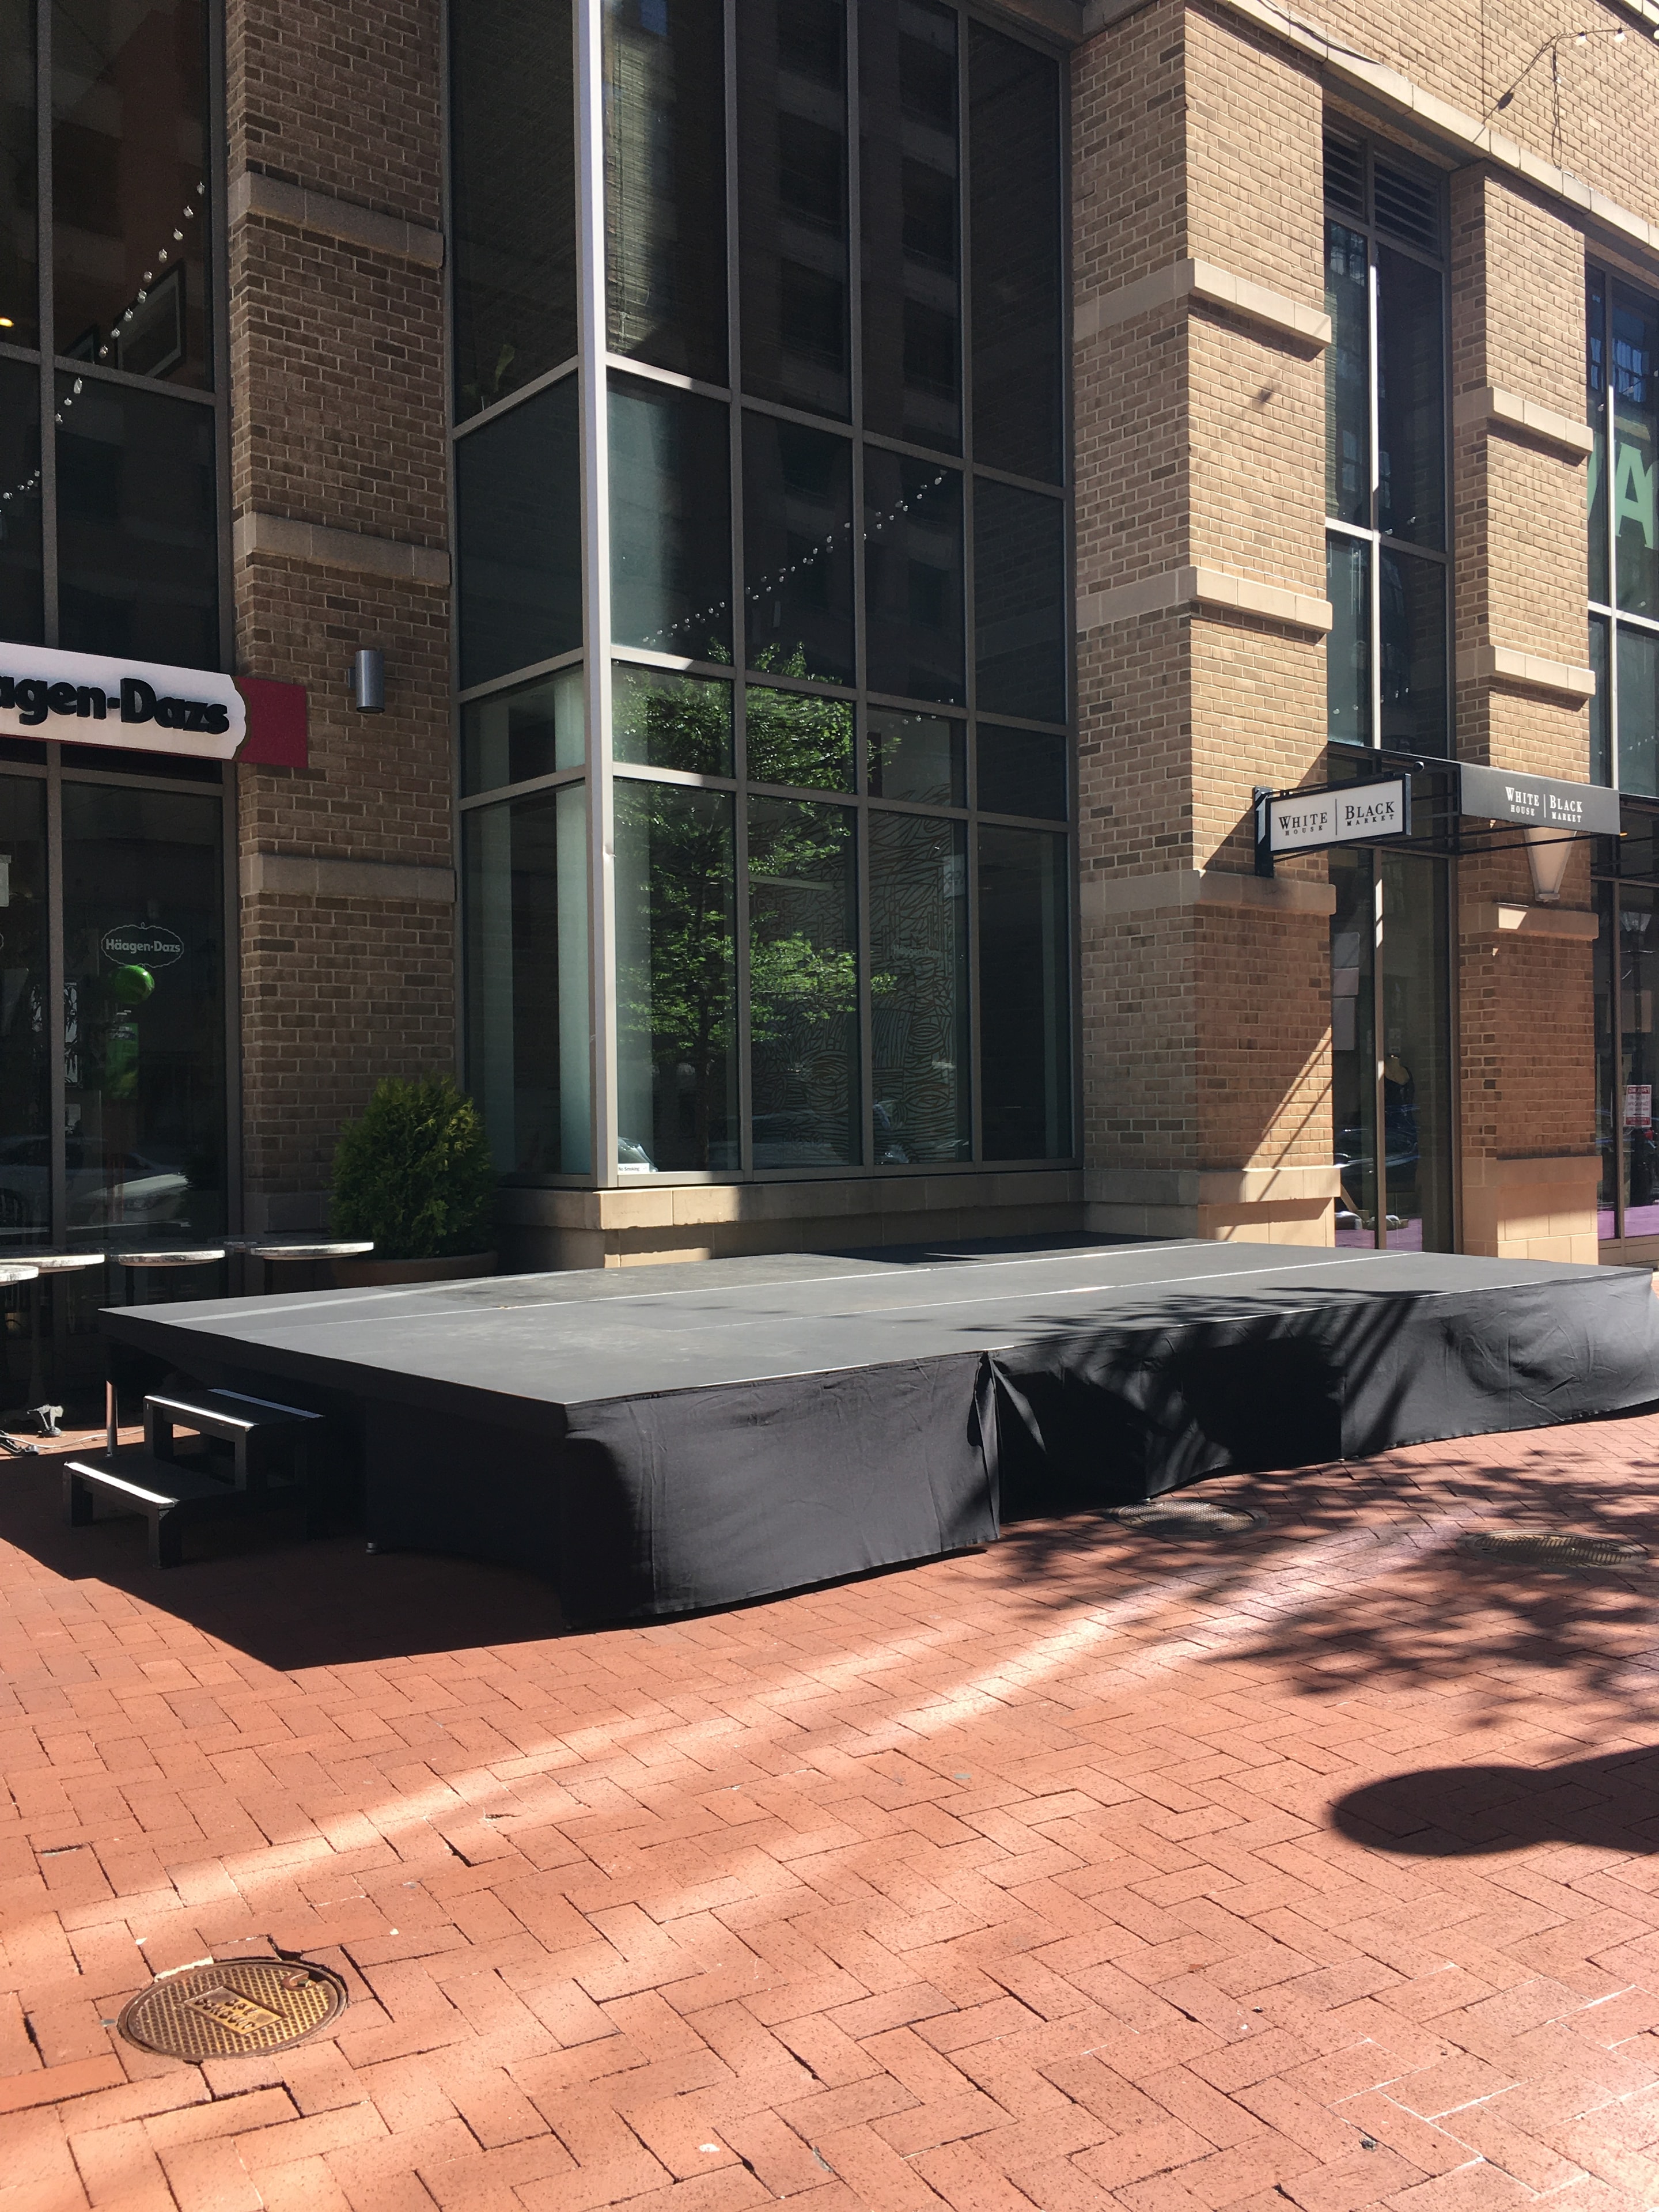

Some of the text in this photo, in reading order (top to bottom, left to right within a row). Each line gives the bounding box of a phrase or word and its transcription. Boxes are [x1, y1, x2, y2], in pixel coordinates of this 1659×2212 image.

[1505, 786, 1540, 806] WHITE
[1345, 801, 1395, 820] BLACK
[1510, 805, 1535, 816] HOUSE
[1550, 795, 1583, 813] BLACK
[1278, 812, 1327, 830] WHITE
[1347, 814, 1395, 826] MARKET
[1552, 812, 1582, 823] MARKET
[1285, 825, 1323, 836] HOUSE
